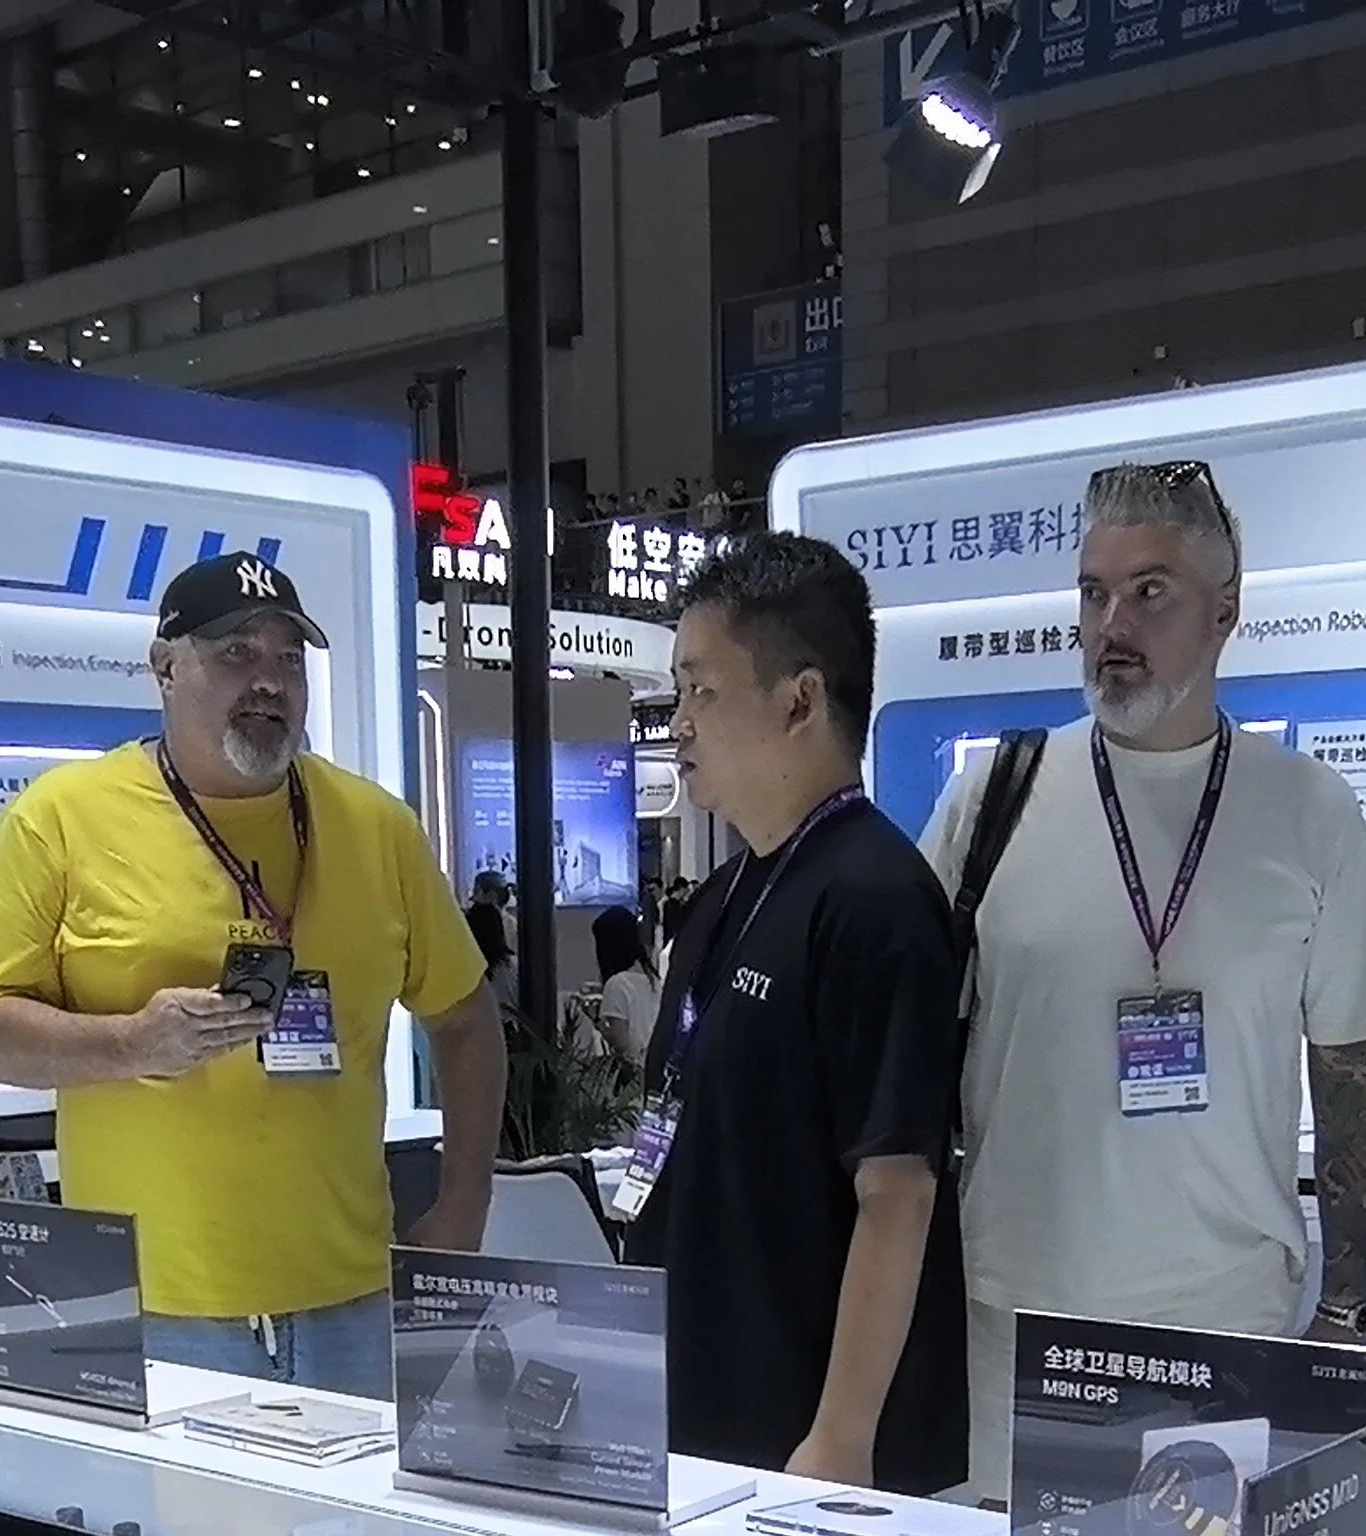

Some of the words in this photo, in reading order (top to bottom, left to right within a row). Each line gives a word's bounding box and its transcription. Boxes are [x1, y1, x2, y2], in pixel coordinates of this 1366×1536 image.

[846, 520, 939, 571] SIYI
[236, 559, 278, 598] NY
[731, 966, 774, 1002] SIYI
[1043, 1344, 1213, 1390] 全球卫星导航模块
[1042, 1378, 1081, 1400] M9N
[1083, 1383, 1119, 1404] GPS
